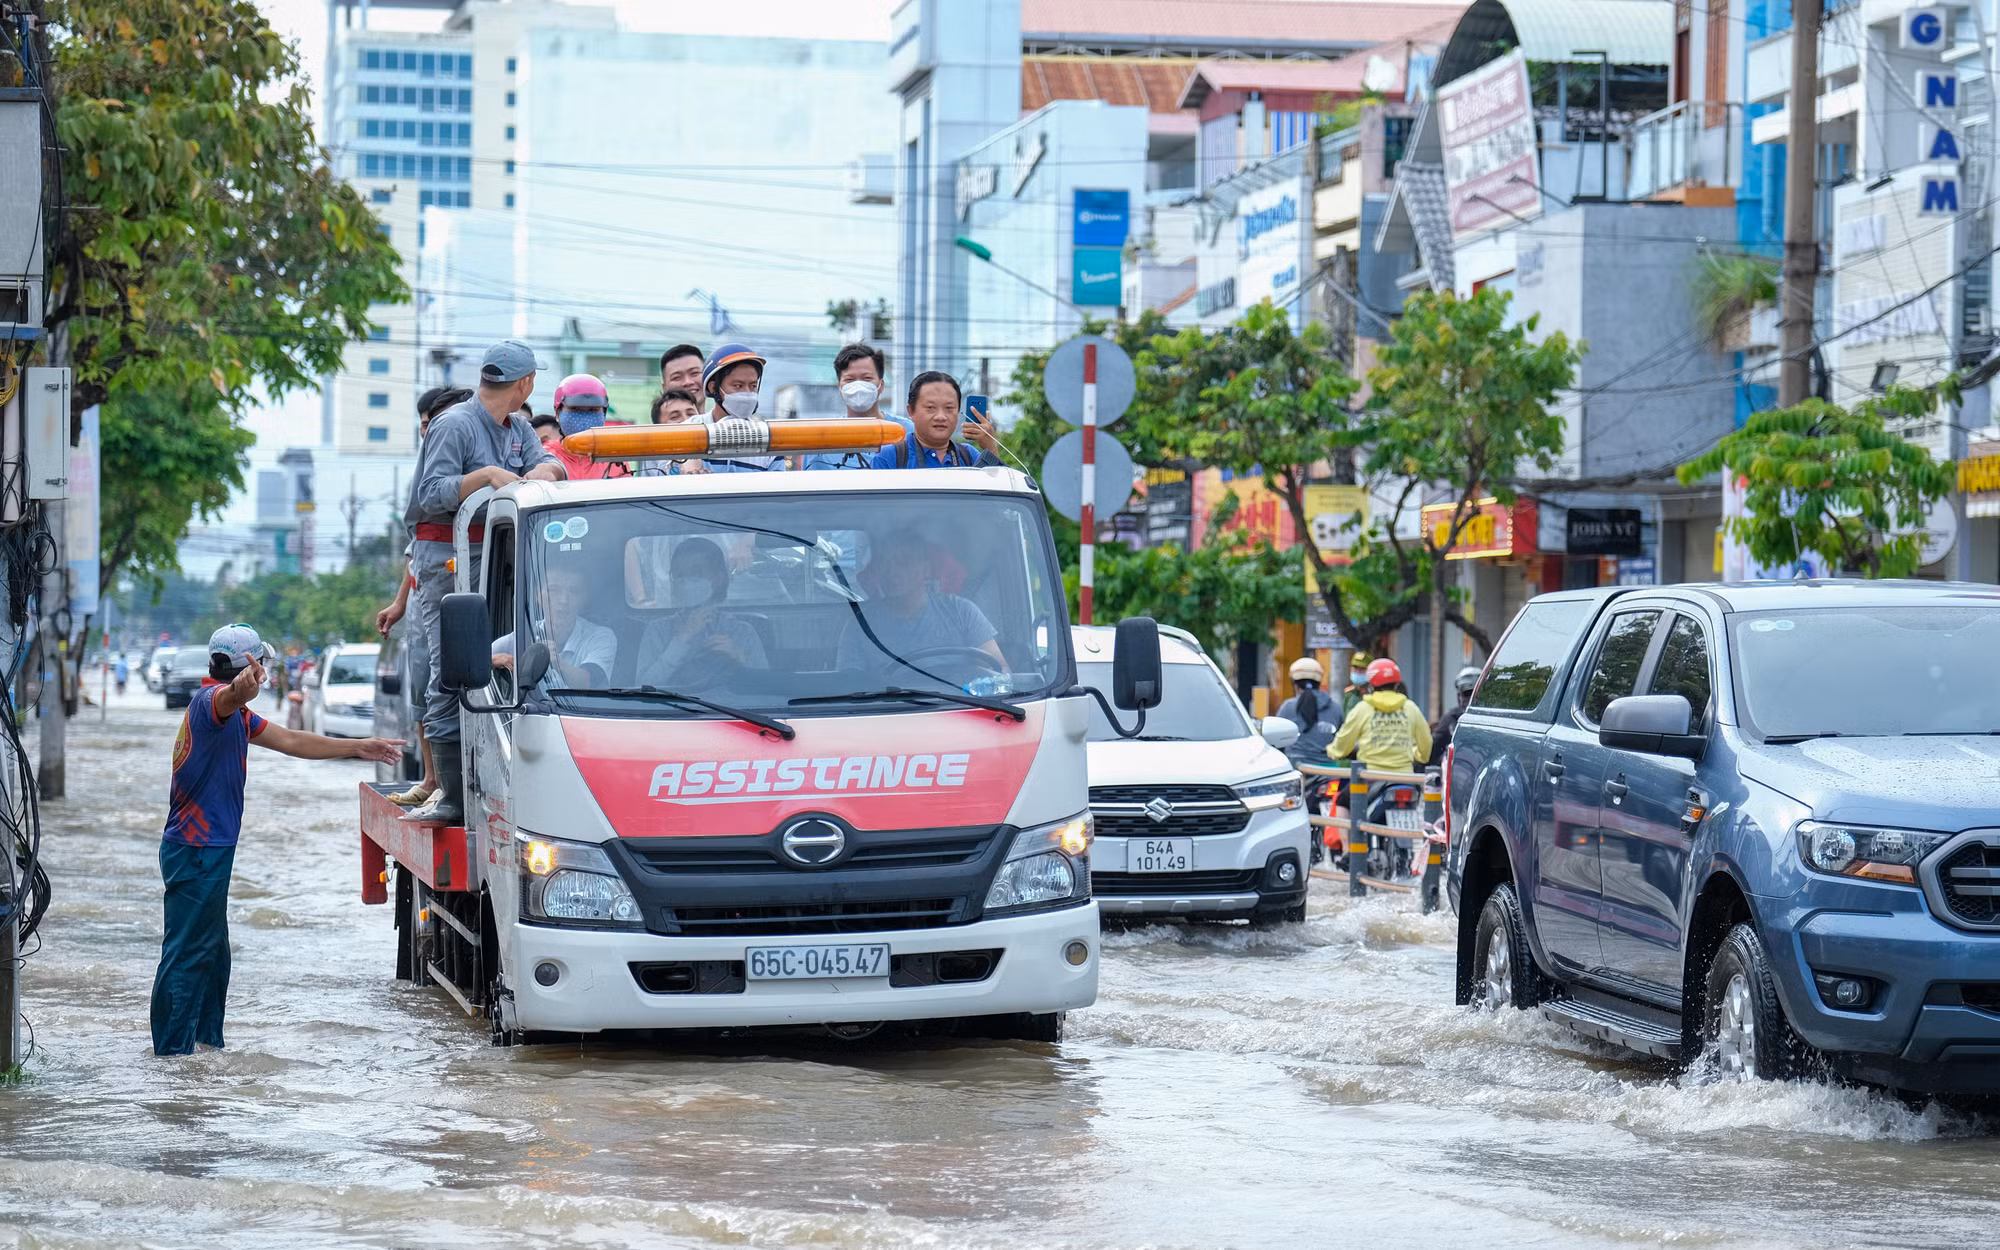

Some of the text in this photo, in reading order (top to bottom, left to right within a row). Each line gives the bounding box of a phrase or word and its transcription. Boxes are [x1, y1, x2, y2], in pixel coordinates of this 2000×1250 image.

[1571, 521, 1612, 538] JOHN
[648, 754, 970, 797] ASSISTANCE
[1146, 841, 1174, 855] 64A
[1136, 856, 1186, 870] 101.49
[751, 947, 884, 977] 65C-045.47
